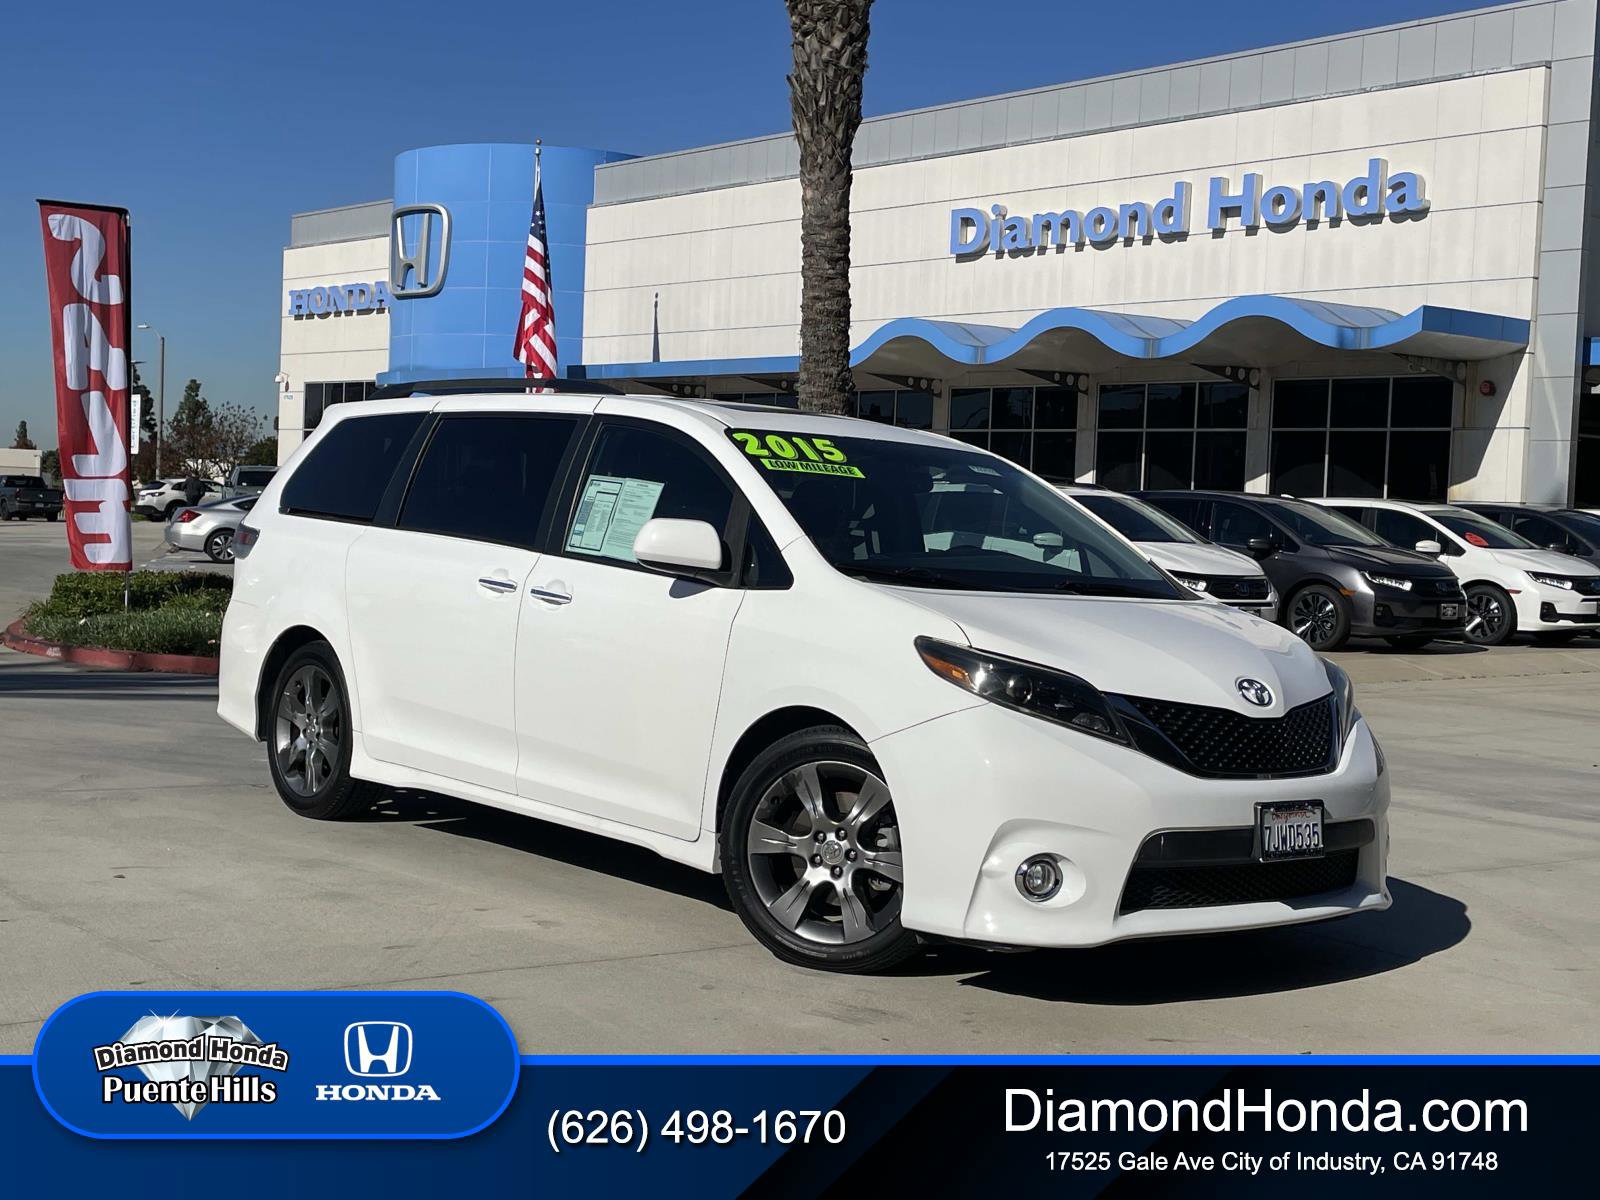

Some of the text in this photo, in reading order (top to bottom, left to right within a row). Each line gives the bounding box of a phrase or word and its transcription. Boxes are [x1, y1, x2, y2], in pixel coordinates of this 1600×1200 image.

[949, 157, 1431, 256] Diamond Honda
[288, 280, 391, 316] HONDA
[732, 432, 847, 463] 2015
[768, 459, 858, 476] LOW MILEAGE
[1264, 822, 1321, 852] 7JWD535
